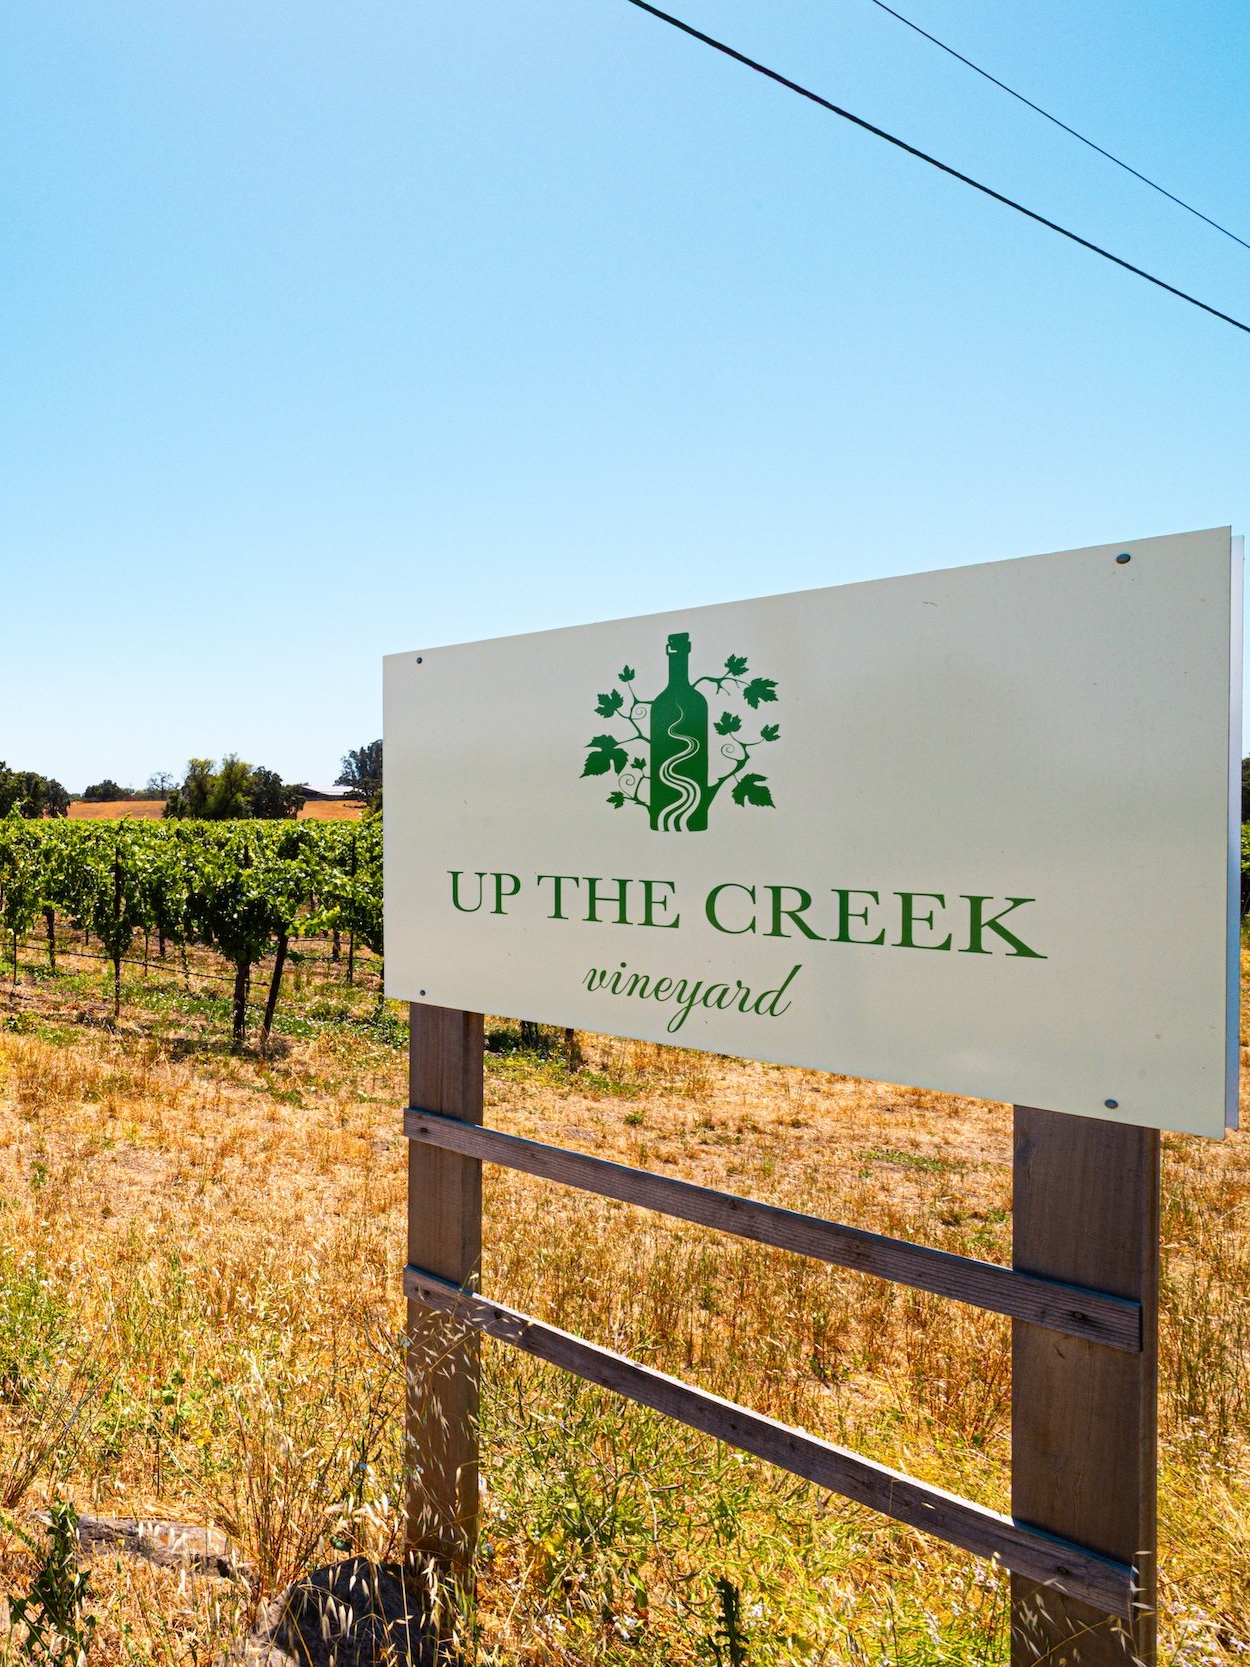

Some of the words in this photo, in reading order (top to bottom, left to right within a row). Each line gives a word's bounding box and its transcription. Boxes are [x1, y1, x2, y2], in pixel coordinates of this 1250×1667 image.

[447, 870, 521, 915] UP
[537, 874, 680, 929] THE
[705, 883, 1048, 959] CREEK
[582, 964, 802, 1033] vineyard
